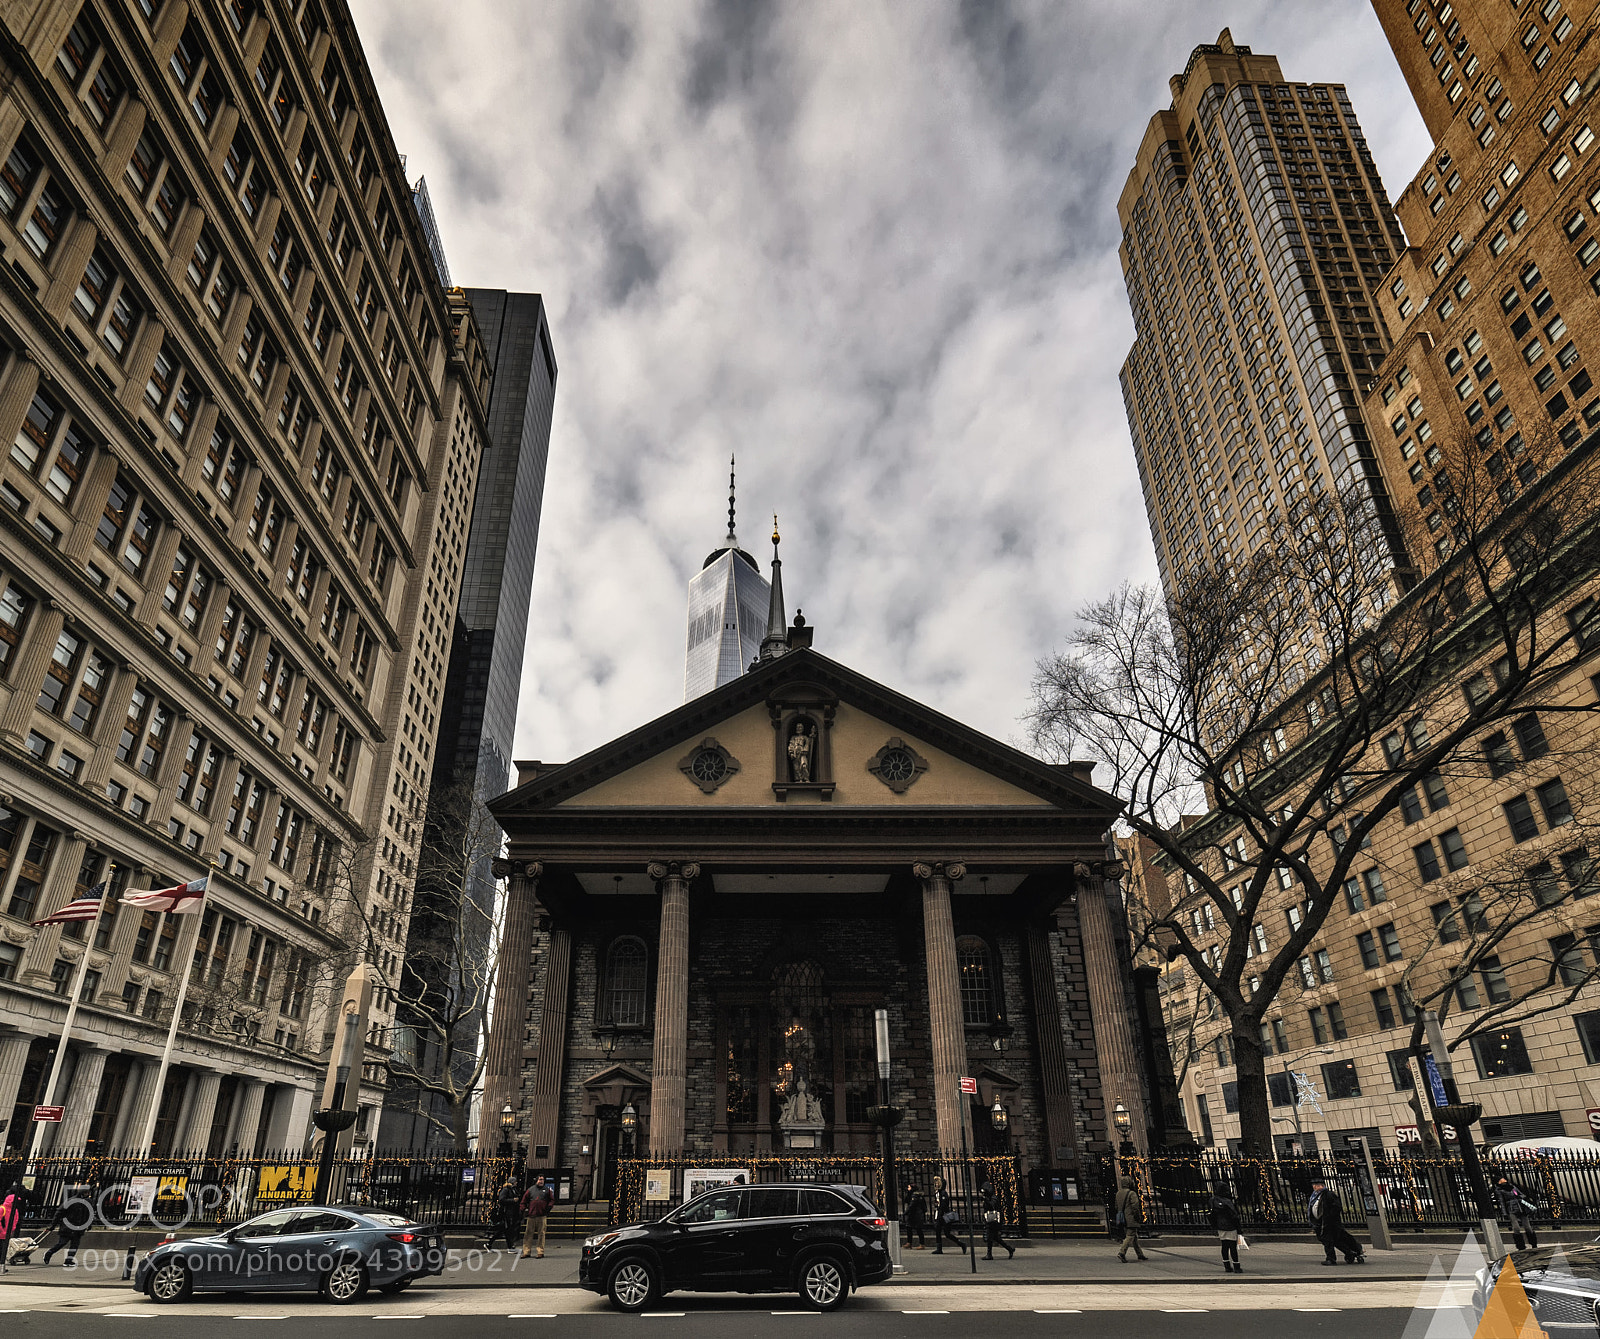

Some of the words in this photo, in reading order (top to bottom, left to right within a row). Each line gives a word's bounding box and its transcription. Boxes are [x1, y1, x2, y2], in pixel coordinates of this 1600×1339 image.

[1419, 1089, 1430, 1116] CHAPEL
[1396, 1124, 1457, 1143] STAS
[258, 1166, 320, 1191] MLK
[256, 1190, 299, 1199] JANUARY
